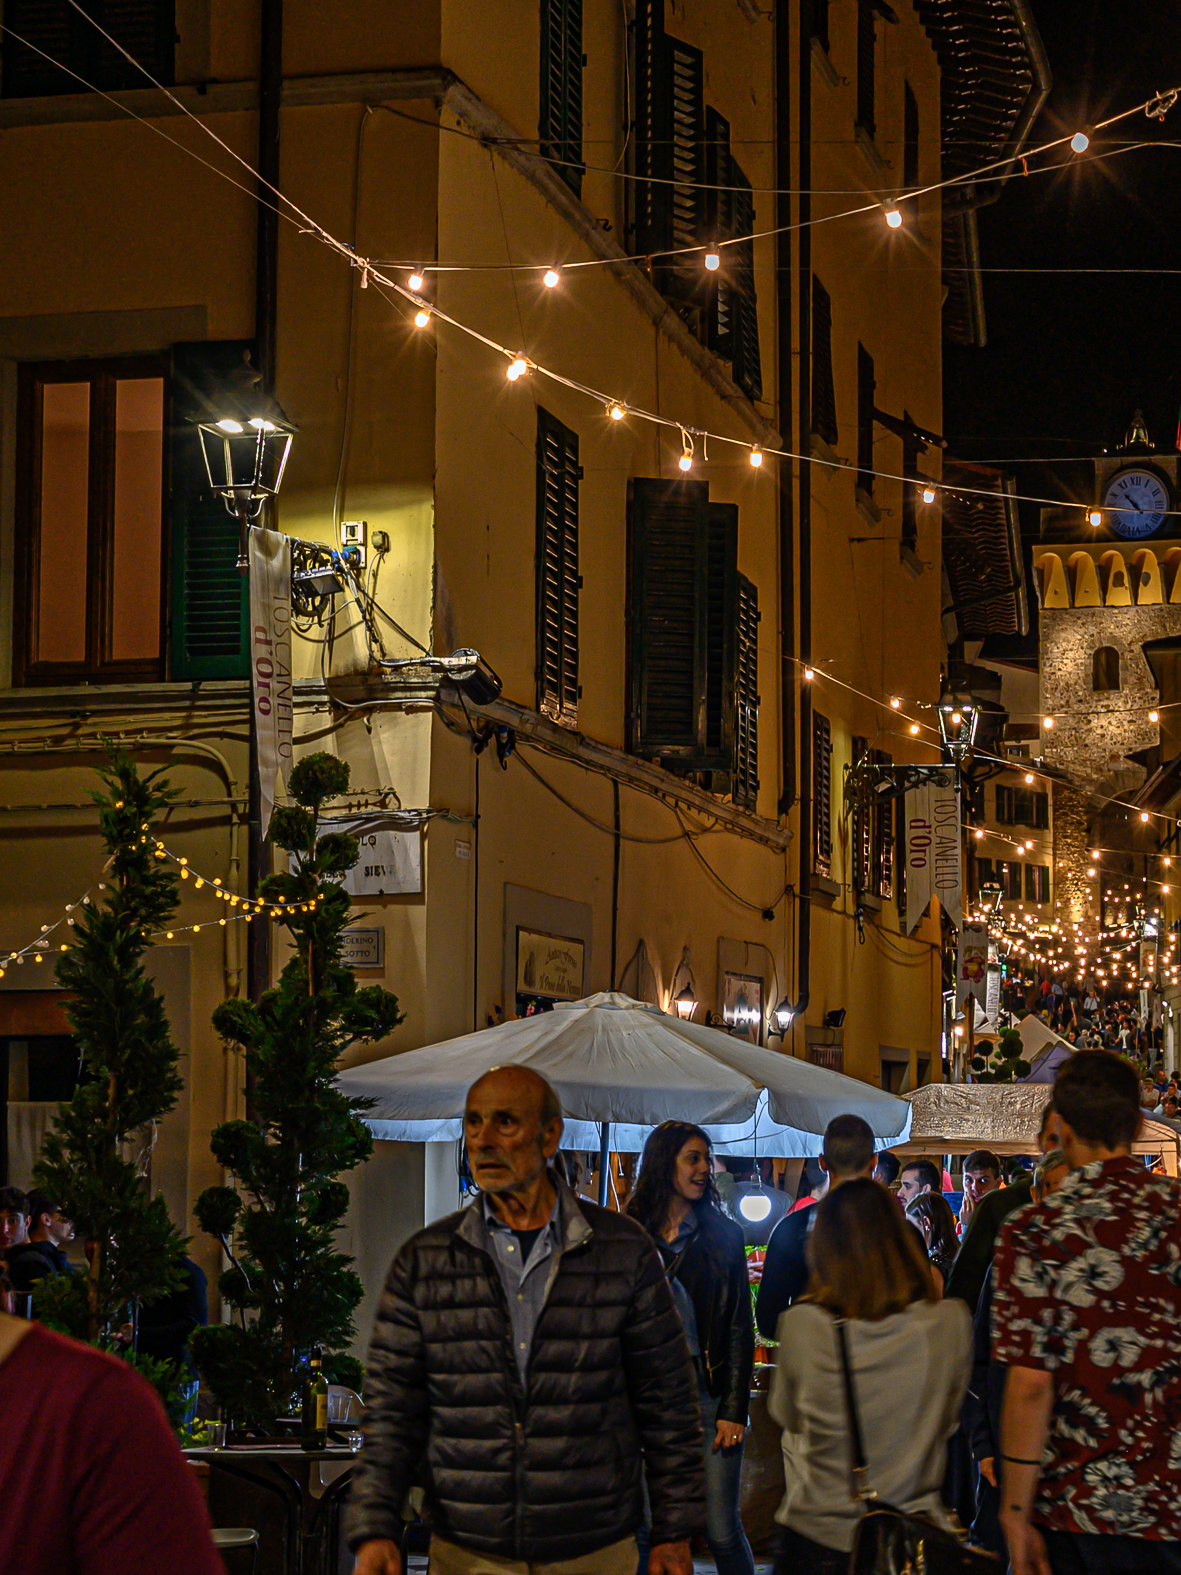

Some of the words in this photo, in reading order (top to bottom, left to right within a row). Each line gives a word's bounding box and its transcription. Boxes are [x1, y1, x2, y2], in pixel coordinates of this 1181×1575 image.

[254, 625, 273, 717] d'Oro
[273, 595, 293, 760] TOSCANELLO
[909, 817, 932, 869] d'Oro
[934, 798, 959, 891] TOSCANELLO
